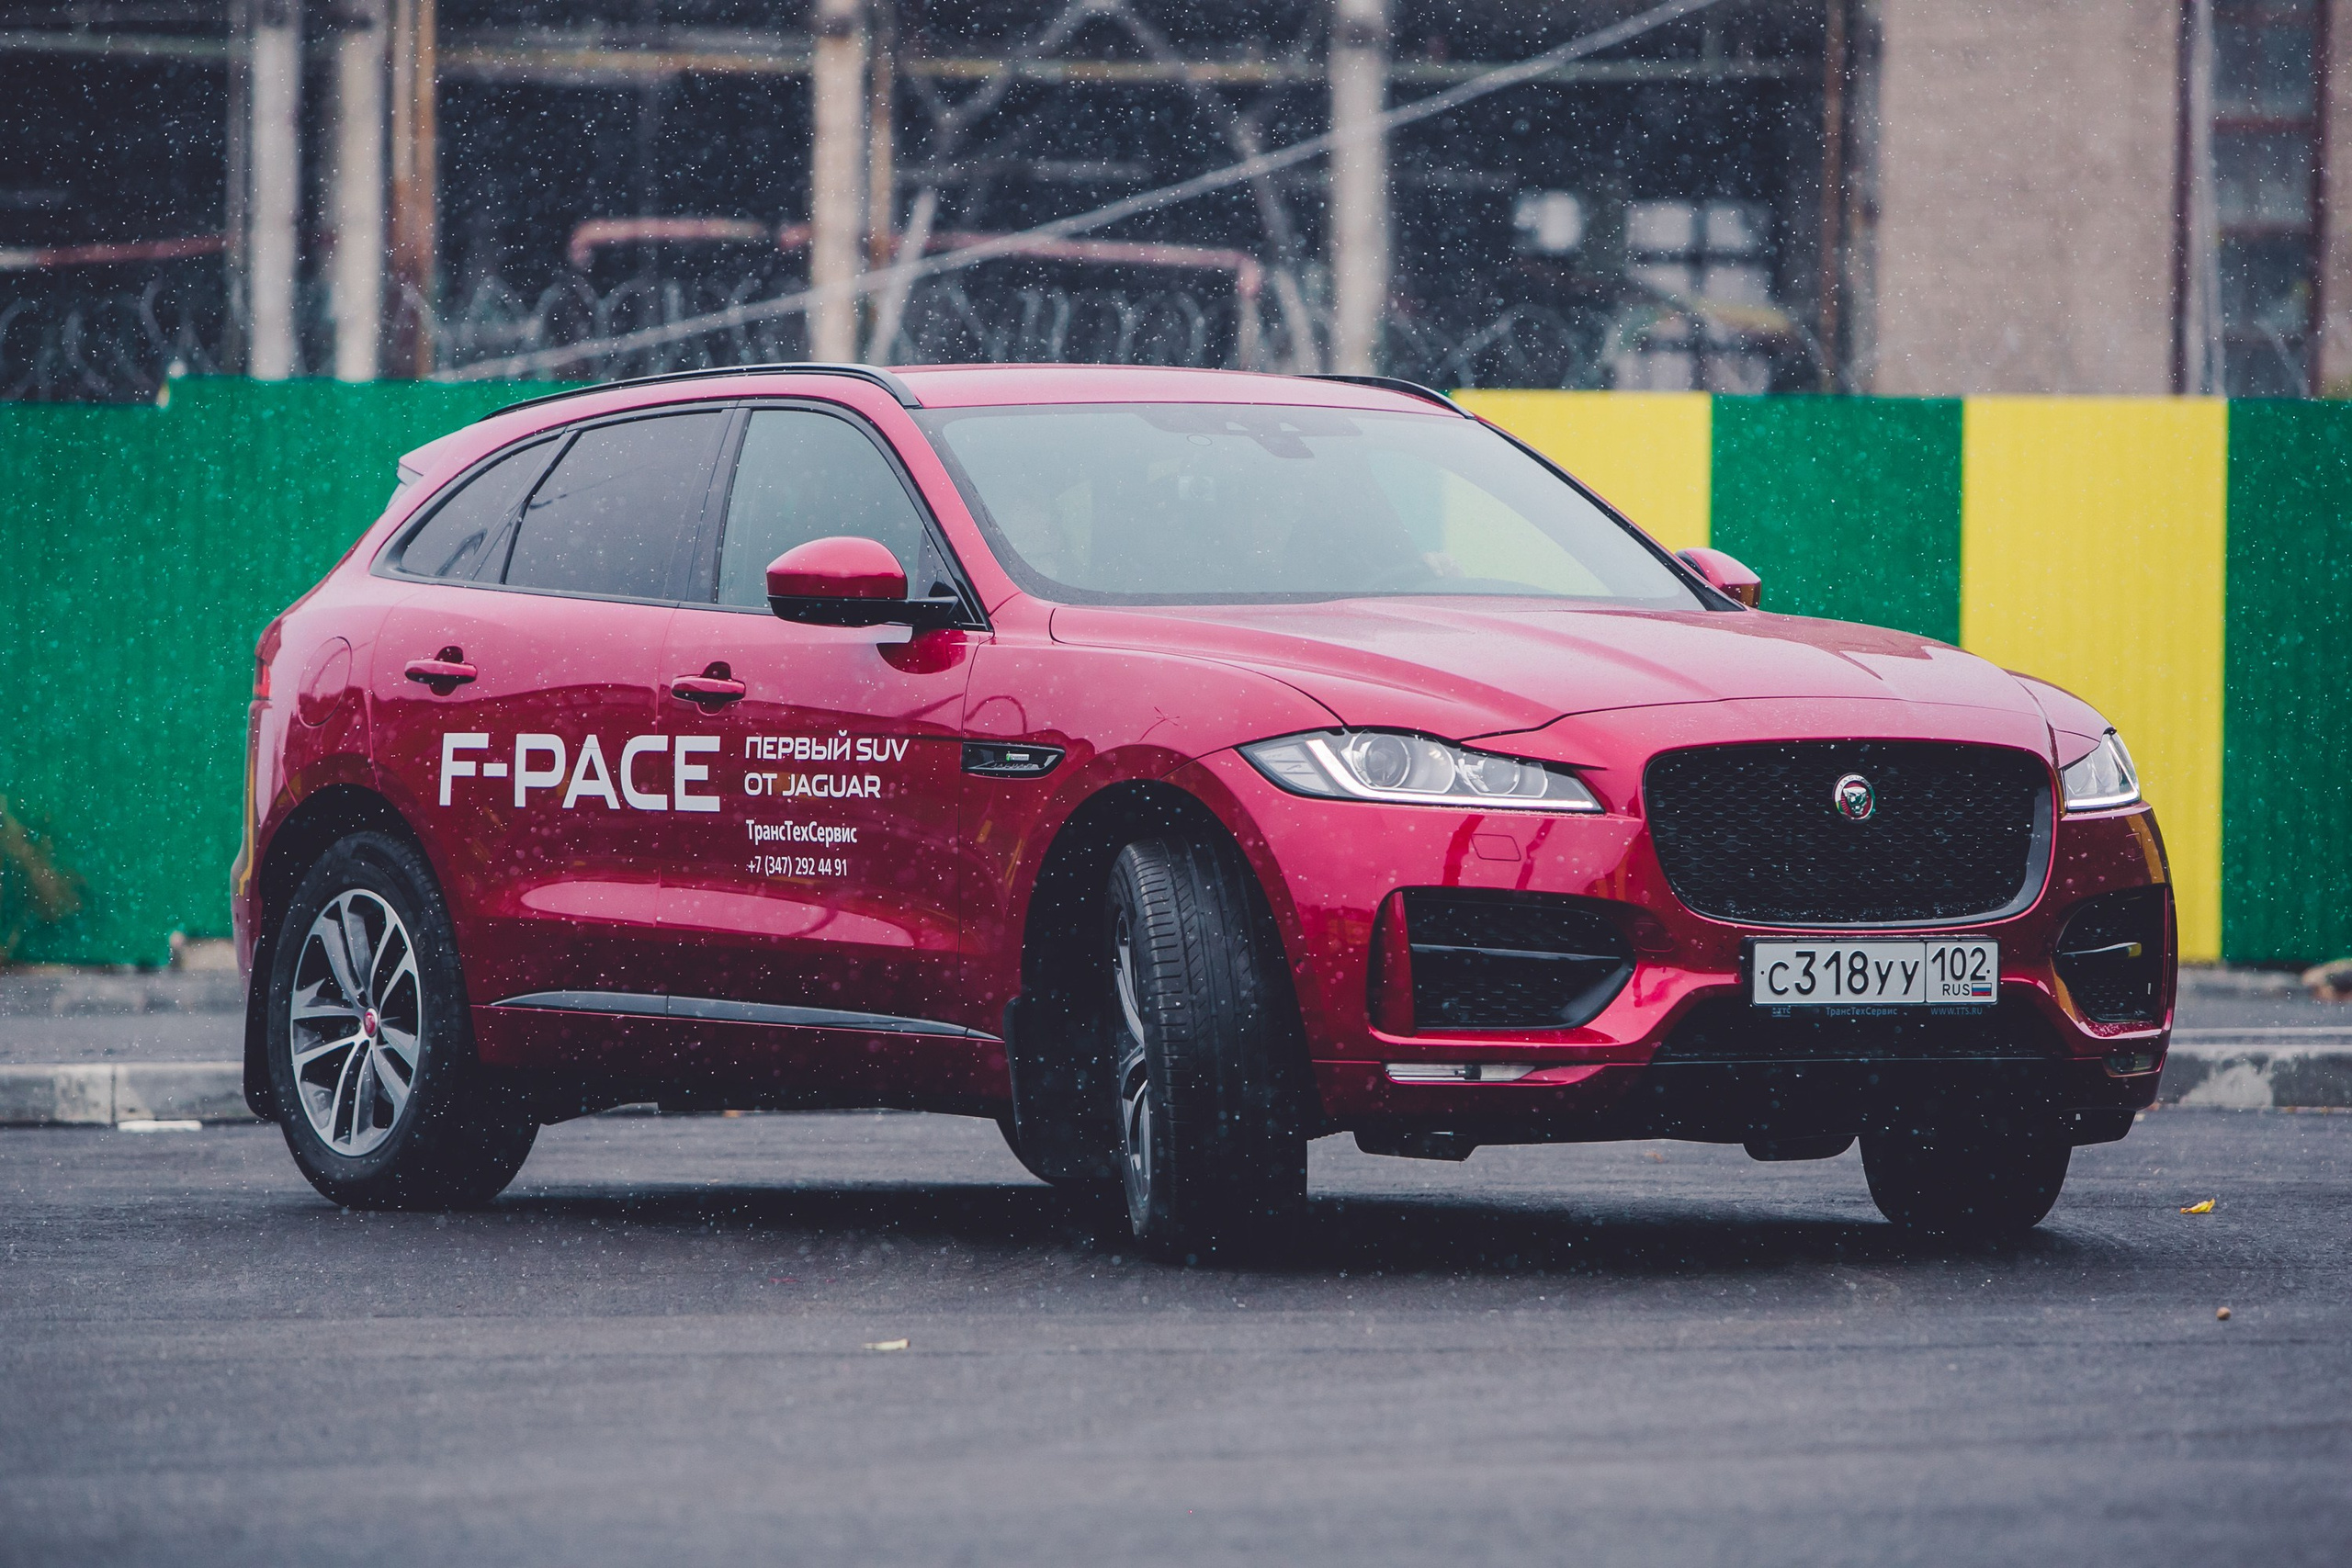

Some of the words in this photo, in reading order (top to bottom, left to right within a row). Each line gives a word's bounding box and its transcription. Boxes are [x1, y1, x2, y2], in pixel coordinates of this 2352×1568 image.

[745, 729, 852, 761] ПЕРВЫЙ
[856, 738, 910, 762] SUV
[438, 732, 721, 812] F-PACE
[744, 773, 778, 796] ОТ
[782, 773, 882, 798] JAGUAR
[746, 818, 858, 848] ТрансТехСервис
[747, 856, 762, 874] +7
[764, 855, 793, 877] (347)
[795, 857, 816, 875] 292
[818, 858, 832, 876] 44
[835, 859, 848, 876] 91
[1931, 946, 1987, 982] 102
[1942, 983, 1971, 997] RUS
[1826, 1007, 1898, 1017] ТрансТехСервис
[1931, 1007, 1983, 1015] WWW.TTS.RU
